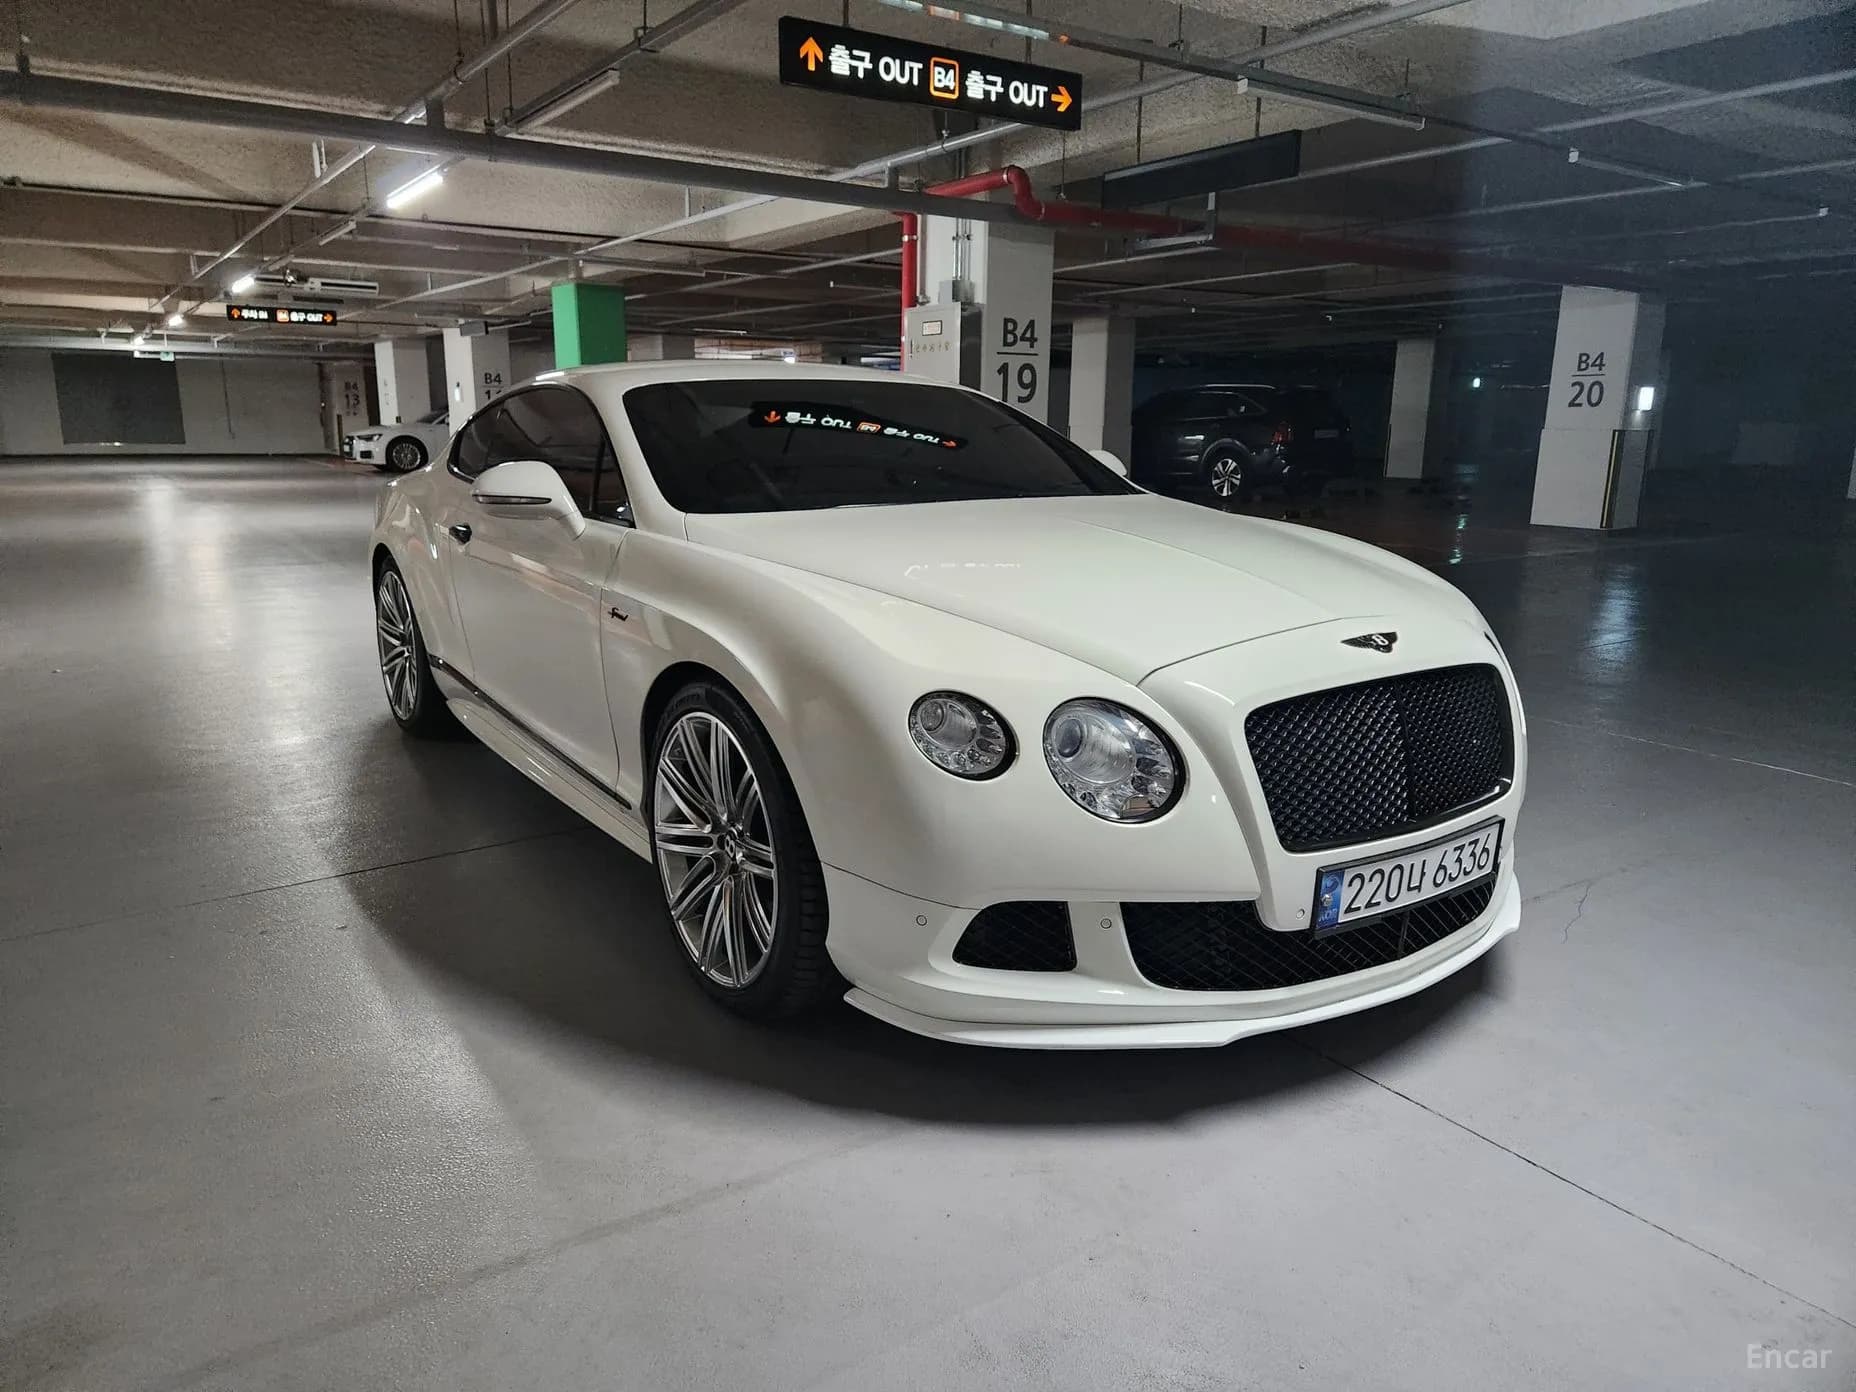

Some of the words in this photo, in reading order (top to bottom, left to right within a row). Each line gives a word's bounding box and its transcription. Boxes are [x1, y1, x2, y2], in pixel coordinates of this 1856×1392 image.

[828, 44, 874, 80] 출구
[878, 56, 923, 87] OUT
[933, 67, 956, 90] B4
[964, 70, 1004, 102] 출구
[1008, 81, 1048, 108] OUT
[1002, 317, 1038, 348] B4
[1577, 352, 1606, 372] B4
[484, 372, 502, 385] B4
[997, 362, 1037, 404] 19
[484, 389, 502, 400] 1
[1568, 380, 1604, 408] 20
[1344, 859, 1427, 915] 220나
[1432, 833, 1491, 888] 6336
